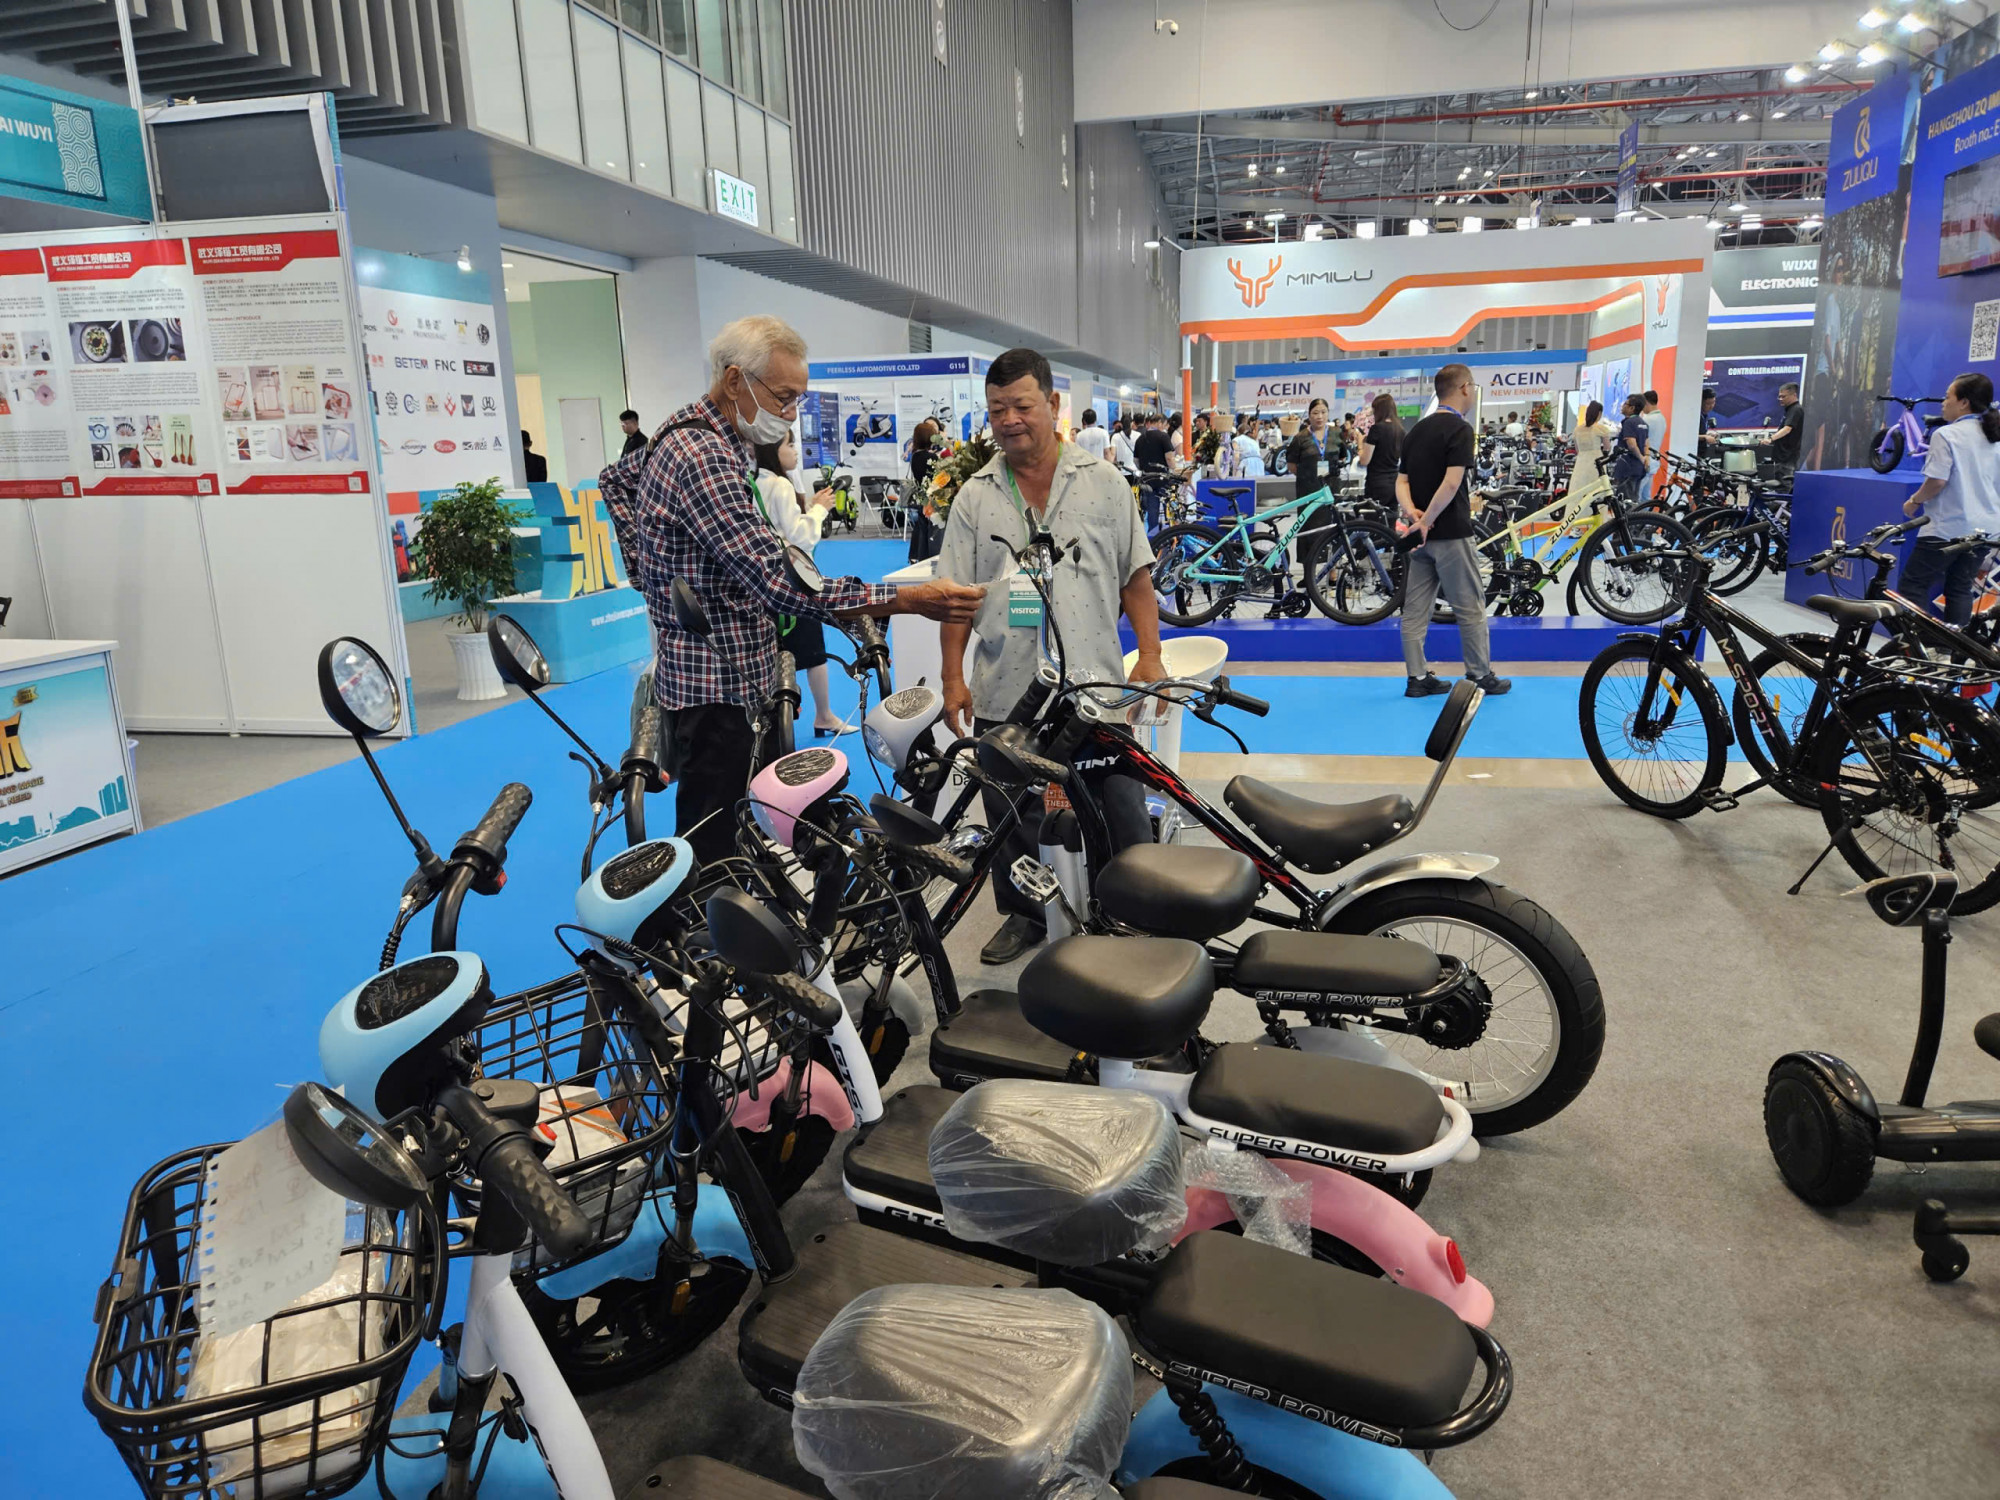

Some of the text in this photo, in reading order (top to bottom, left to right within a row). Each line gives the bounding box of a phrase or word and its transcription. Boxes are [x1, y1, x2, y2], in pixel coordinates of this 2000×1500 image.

[1928, 103, 1974, 140] HANGZHOU
[1974, 97, 1987, 117] ZQ
[14, 119, 53, 143] WUYI
[1954, 130, 1977, 154] Booth
[720, 178, 754, 213] EXIT
[1782, 260, 1817, 271] WUXI
[1741, 277, 1818, 291] ELECTRONIC
[434, 359, 457, 372] FNC
[827, 366, 855, 374] PEERLESS
[856, 365, 896, 373] AUTOMOTIVE
[1490, 371, 1549, 386] ACEIN
[1257, 382, 1311, 397] ACEIN
[1514, 387, 1550, 396] ENERGY
[1257, 398, 1277, 406] NEW
[1550, 505, 1582, 545] ZUUQU
[1275, 513, 1306, 555] ZUUQU
[1074, 755, 1120, 771] TINY
[18, 776, 45, 790] MADE
[8, 793, 32, 806] NEED
[1045, 799, 1073, 809] TNE12
[1255, 990, 1404, 1009] SUPER POWER
[832, 1043, 863, 1112] GTS
[1209, 1126, 1388, 1172] SUPER POWER
[1168, 1360, 1402, 1448] SUPER POWER
